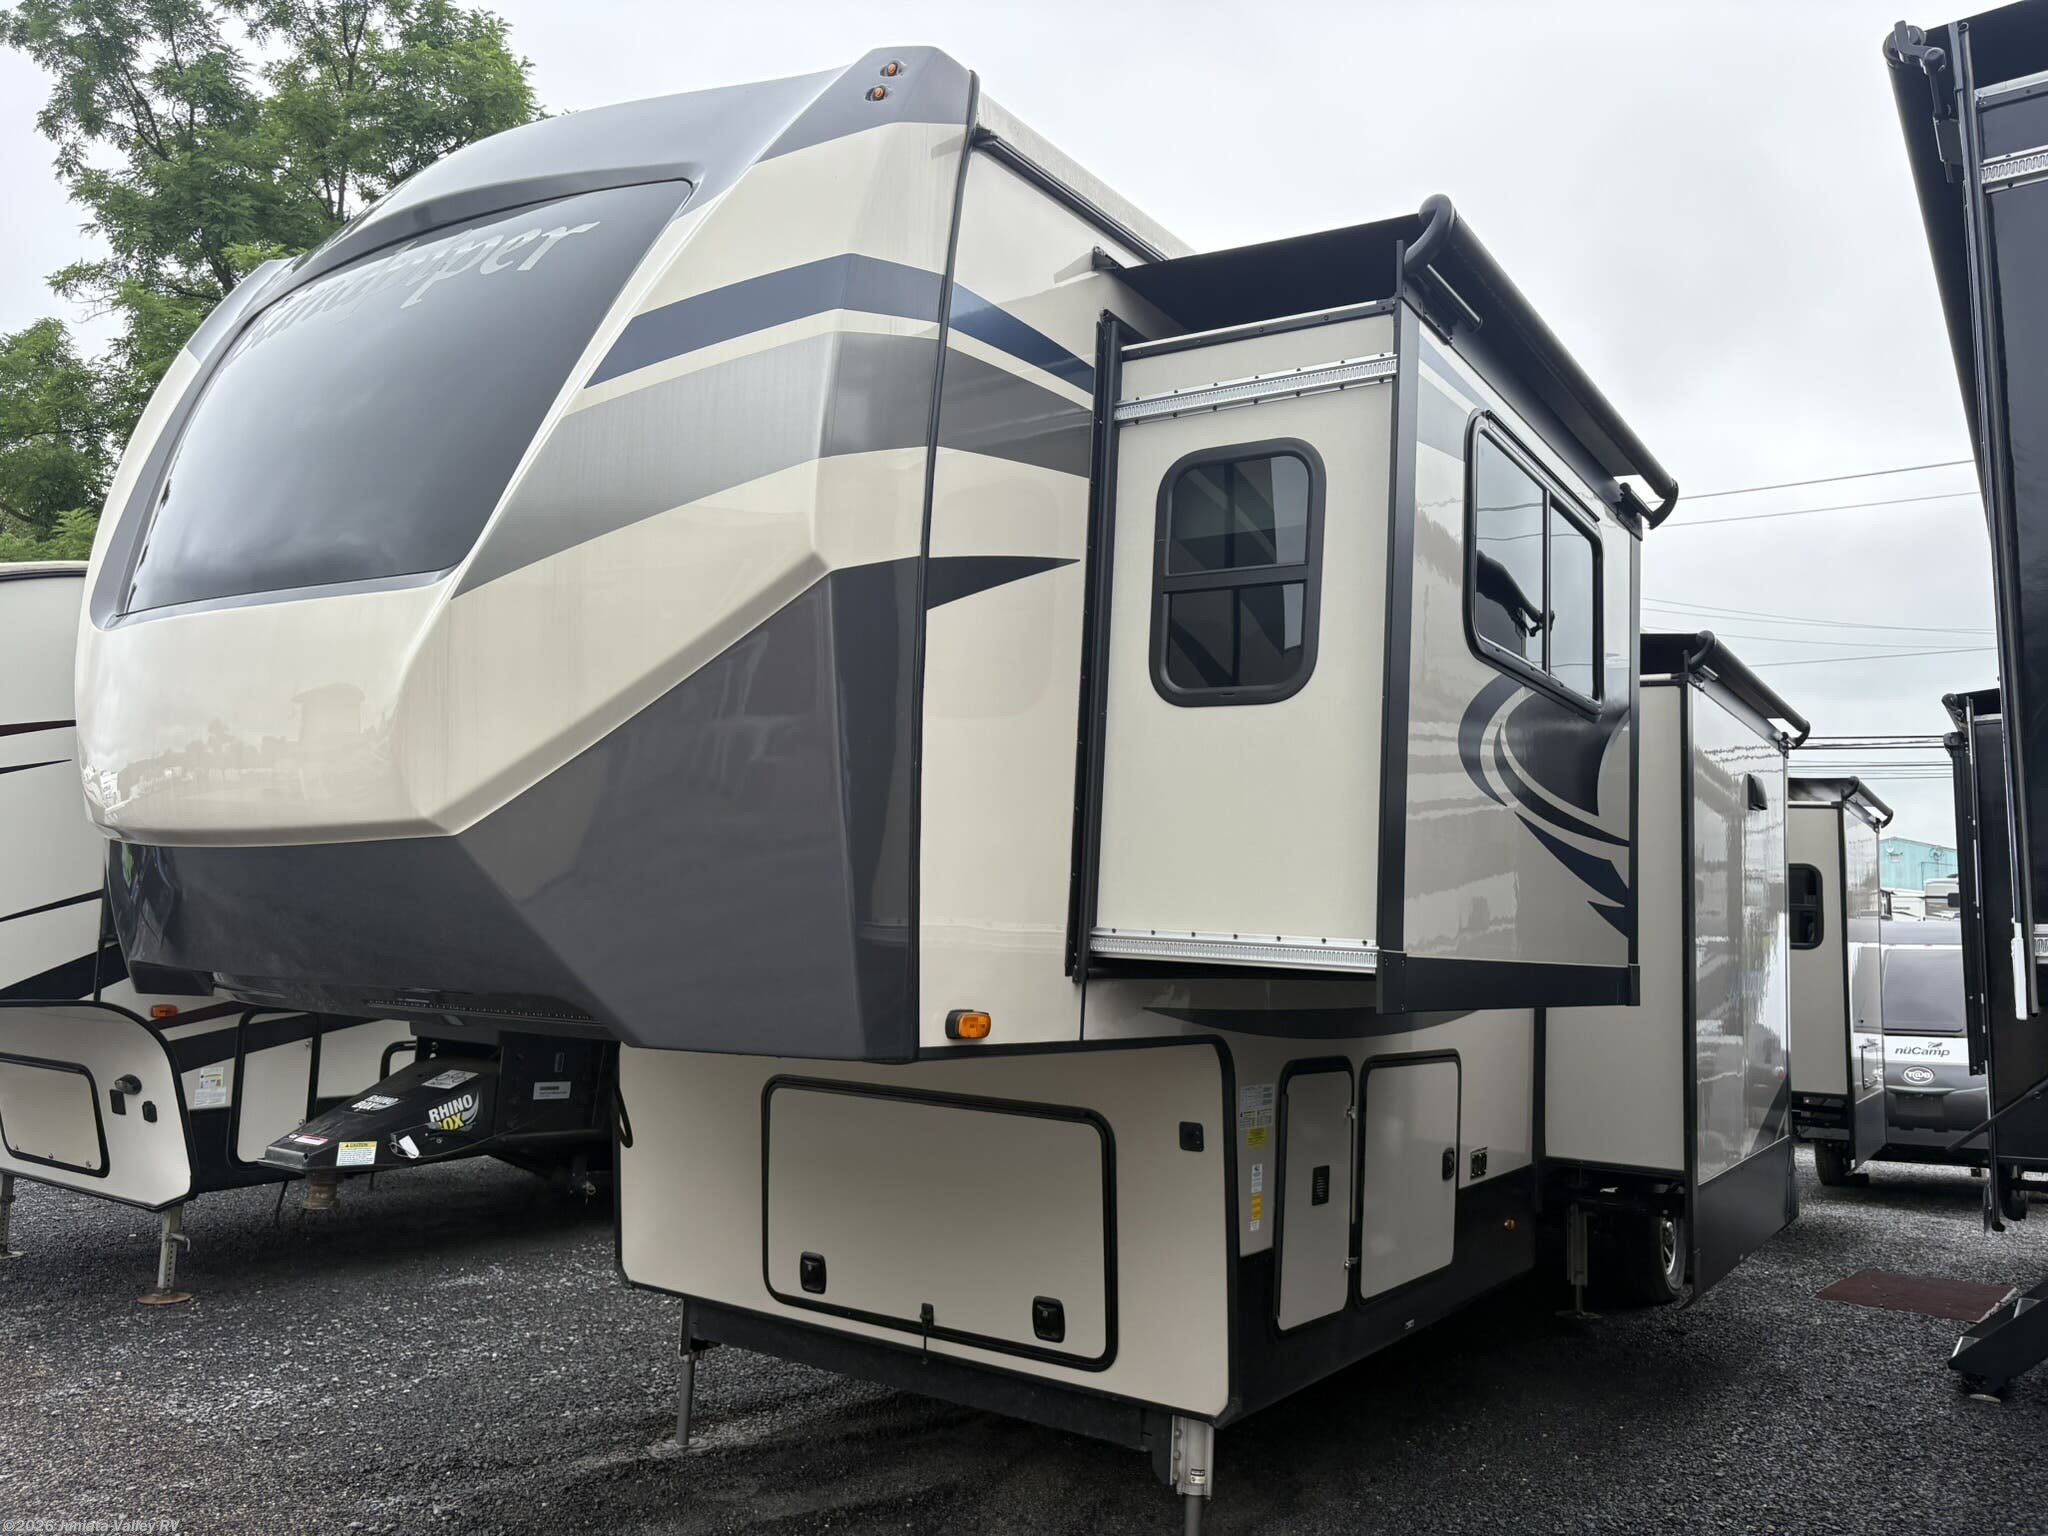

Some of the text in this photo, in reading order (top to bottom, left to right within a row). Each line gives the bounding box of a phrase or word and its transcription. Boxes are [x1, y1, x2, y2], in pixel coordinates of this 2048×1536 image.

[1894, 1046, 1951, 1057] nüCamp
[428, 1094, 473, 1123] RHINO
[435, 1112, 465, 1130] OX
